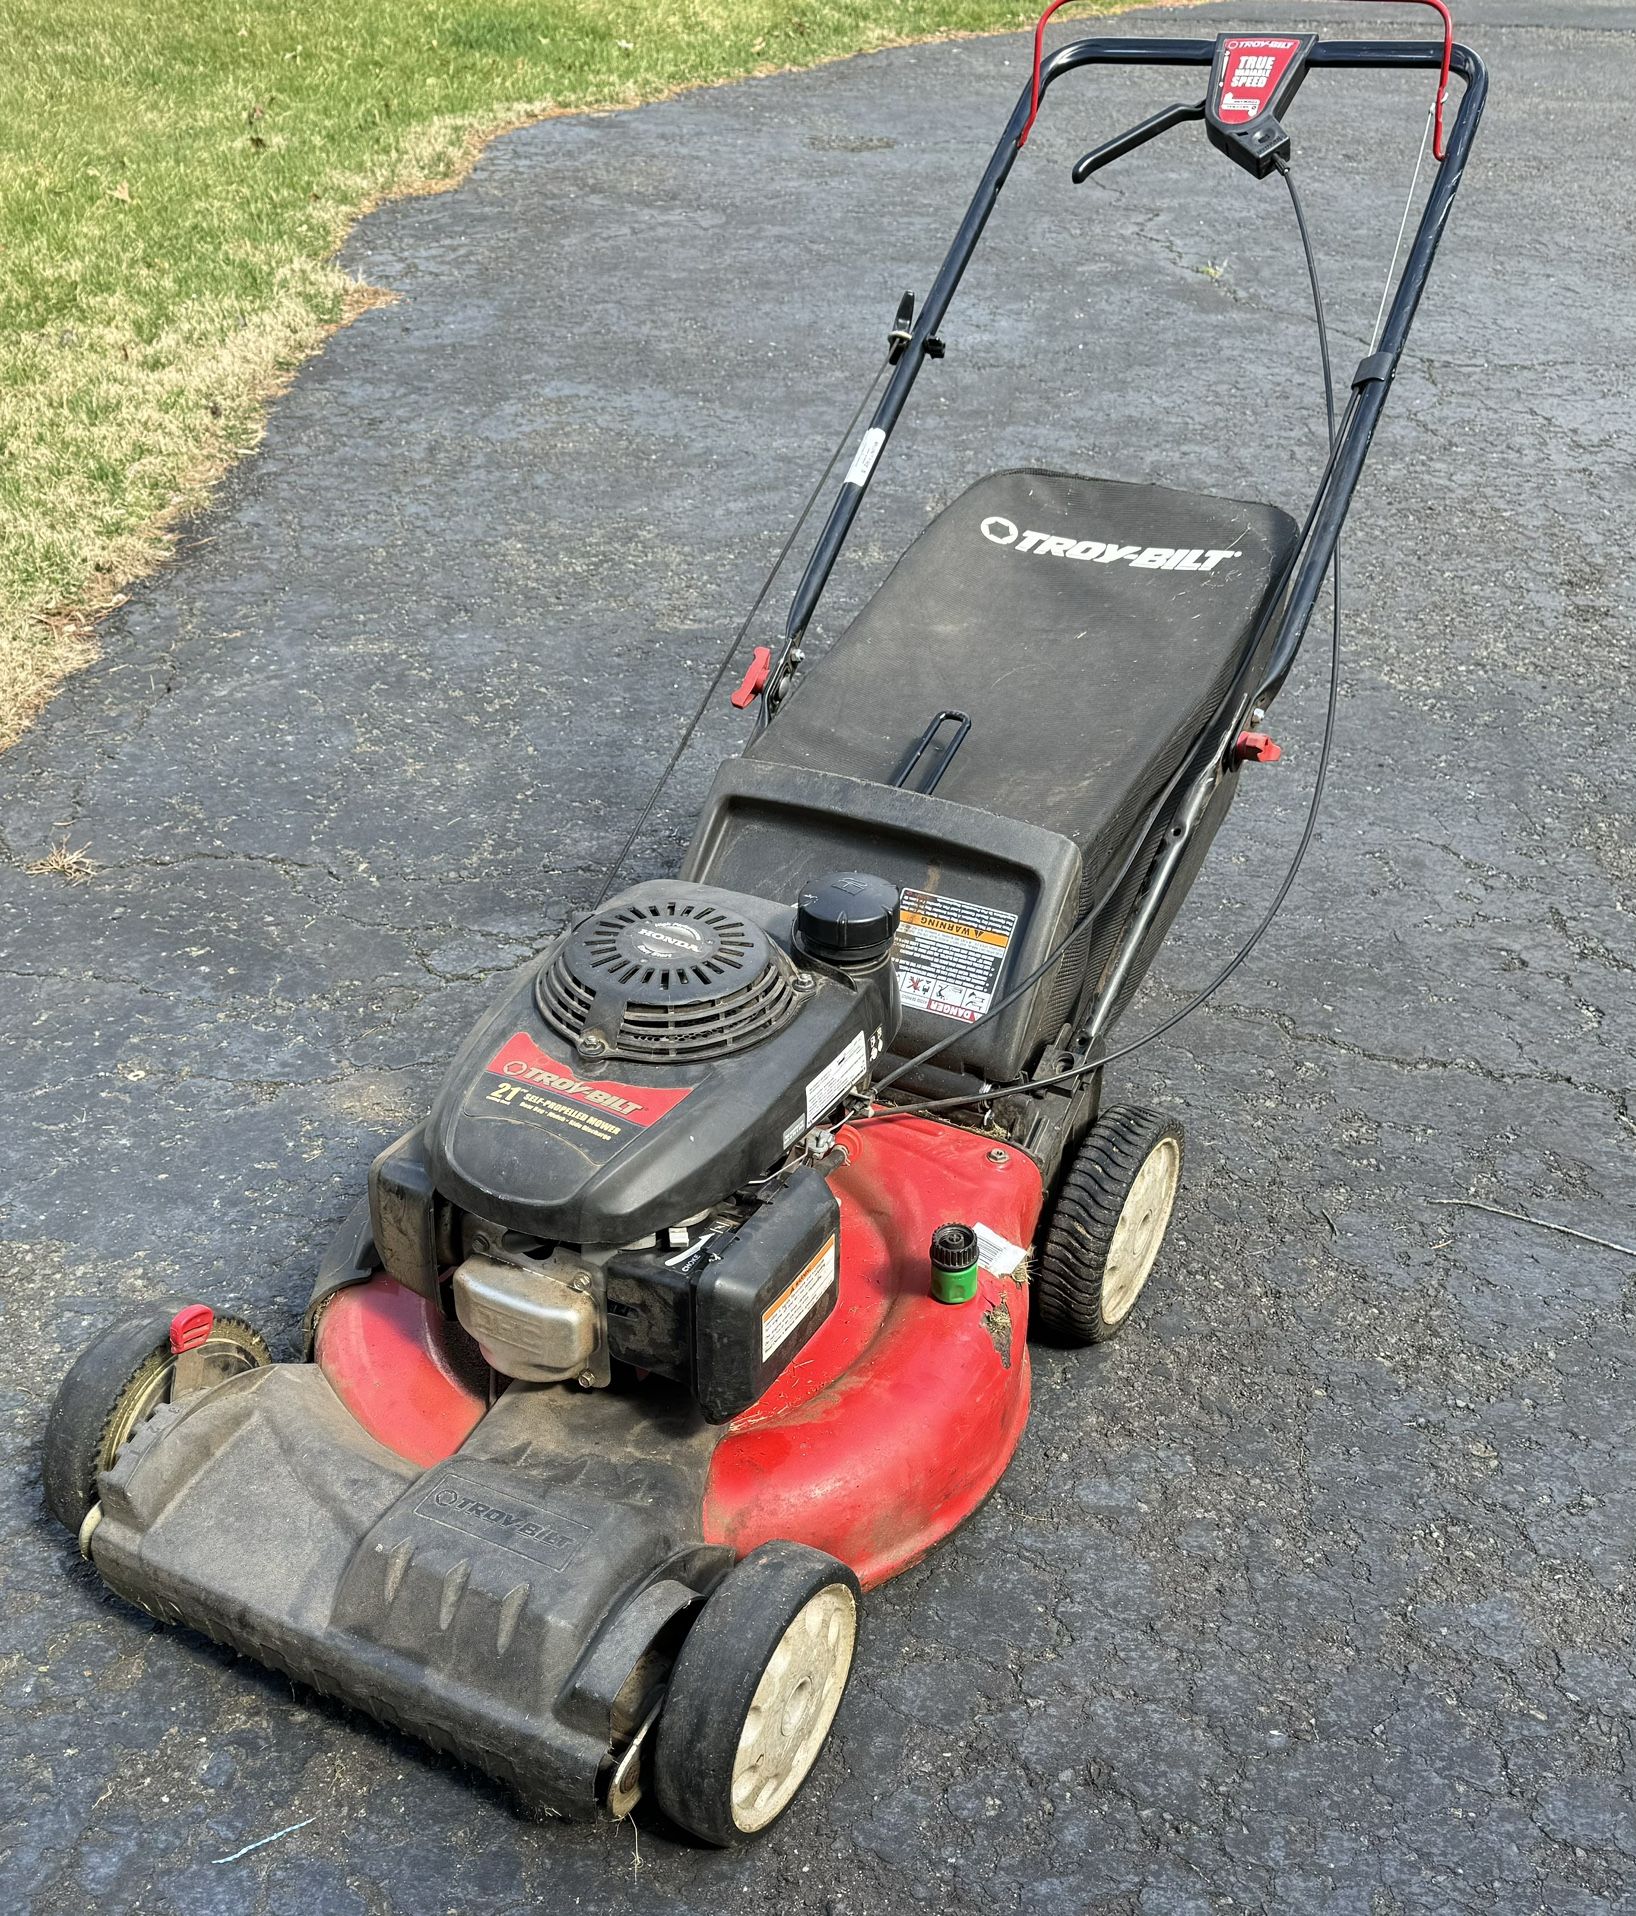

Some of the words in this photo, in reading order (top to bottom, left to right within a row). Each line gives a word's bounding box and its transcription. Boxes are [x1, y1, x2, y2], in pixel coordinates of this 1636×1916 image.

[1239, 41, 1294, 49] TROY-BILT
[1240, 56, 1275, 69] TRUE
[1231, 77, 1268, 87] SPEED
[1015, 530, 1242, 571] TROY-BILT
[920, 917, 970, 937] WARNING
[638, 929, 701, 953] HONDA
[931, 1001, 972, 1019] DANGER
[523, 1067, 643, 1115] TROY-BILT
[523, 1093, 589, 1121] SELF-PROPELLED
[586, 1116, 621, 1135] MOWER
[681, 1254, 701, 1272] CHOKE
[456, 1497, 575, 1550] TROY-BILT
